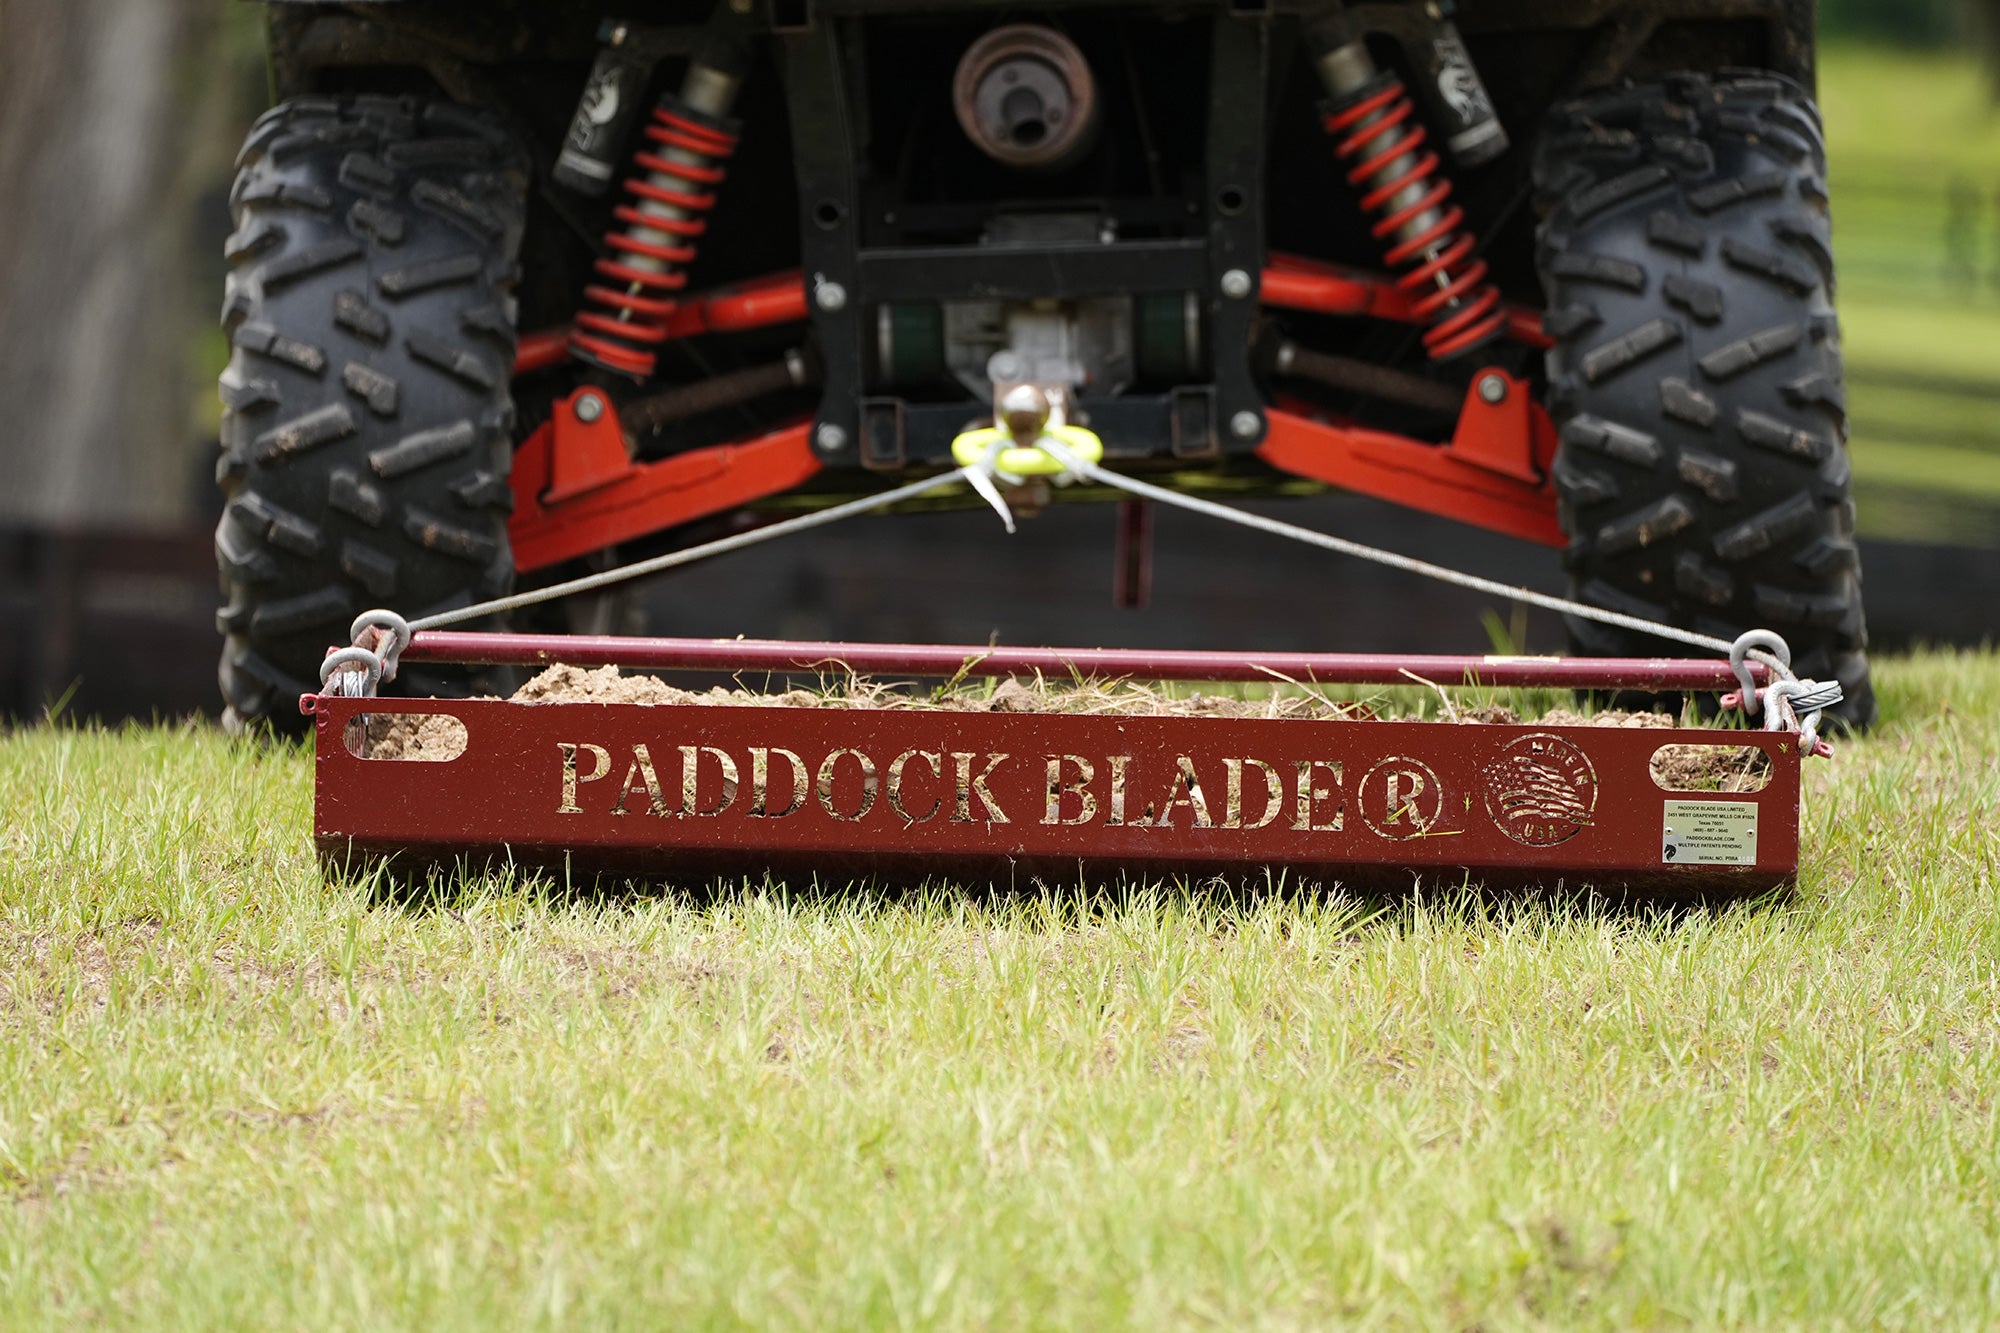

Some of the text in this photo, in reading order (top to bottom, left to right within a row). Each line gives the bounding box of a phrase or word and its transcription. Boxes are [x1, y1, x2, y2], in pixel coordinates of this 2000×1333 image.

[1532, 741, 1577, 767] MADE
[556, 742, 1010, 822] PADDOCK
[1524, 823, 1558, 839] USA
